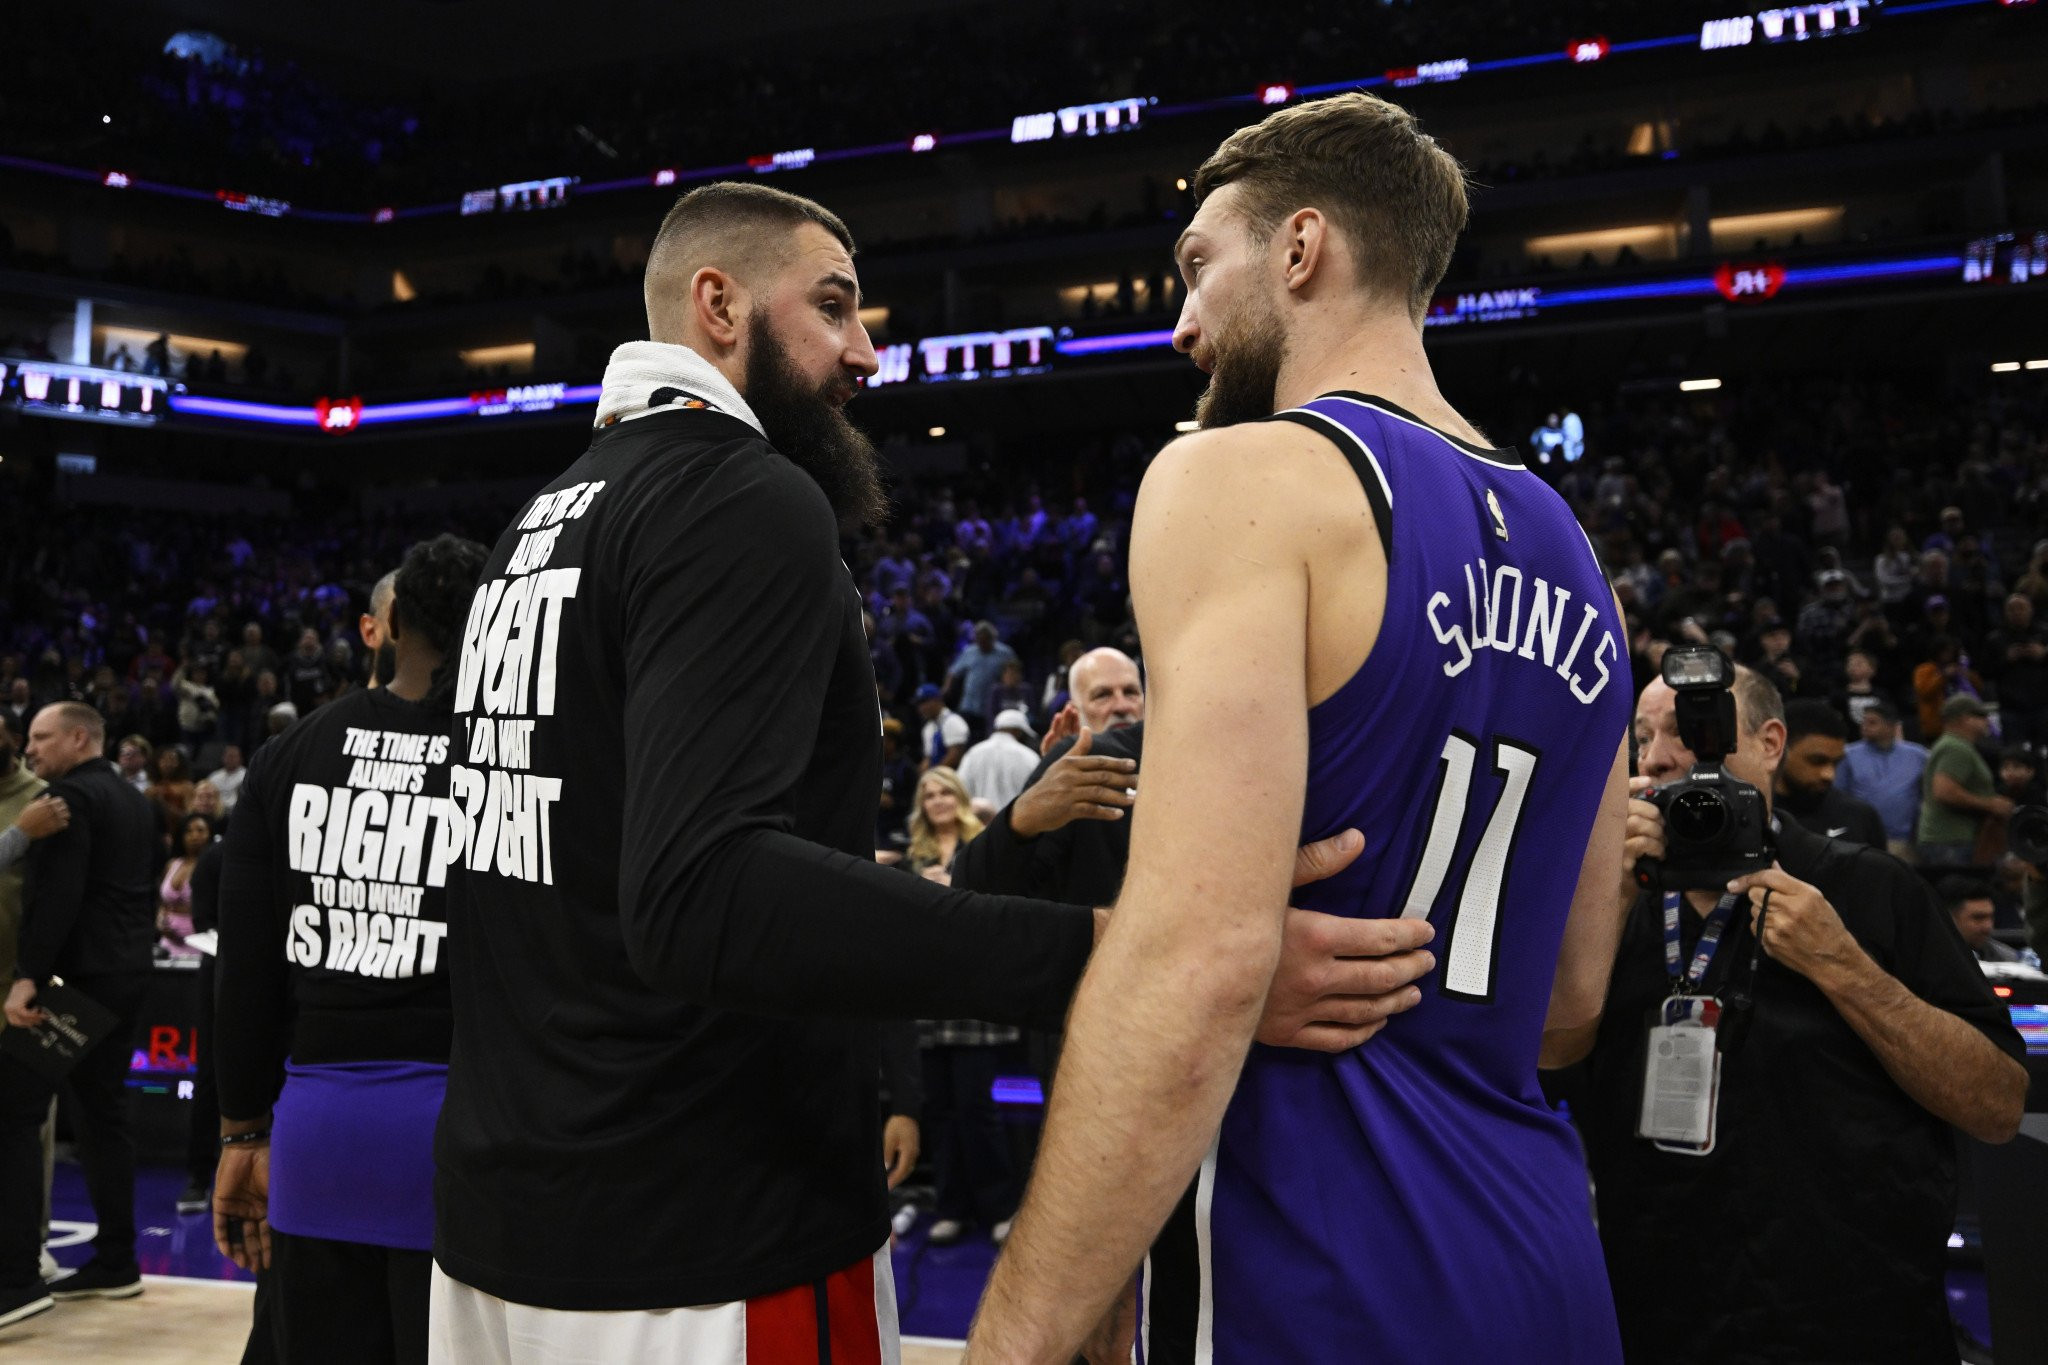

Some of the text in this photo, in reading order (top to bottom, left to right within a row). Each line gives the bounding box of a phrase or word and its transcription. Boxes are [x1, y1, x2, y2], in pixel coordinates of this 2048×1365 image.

[454, 567, 582, 716] RIGHT
[342, 727, 381, 760] THE
[380, 731, 429, 764] TIME
[425, 735, 451, 765] IS
[347, 758, 427, 794] ALWAYS
[1691, 772, 1720, 781] Canon
[288, 783, 450, 888] RIGHT
[466, 768, 562, 886] RIGHT
[311, 875, 425, 917] TO DO WHAT
[1398, 729, 1541, 1004] 11
[286, 903, 448, 980] IS RIGHT
